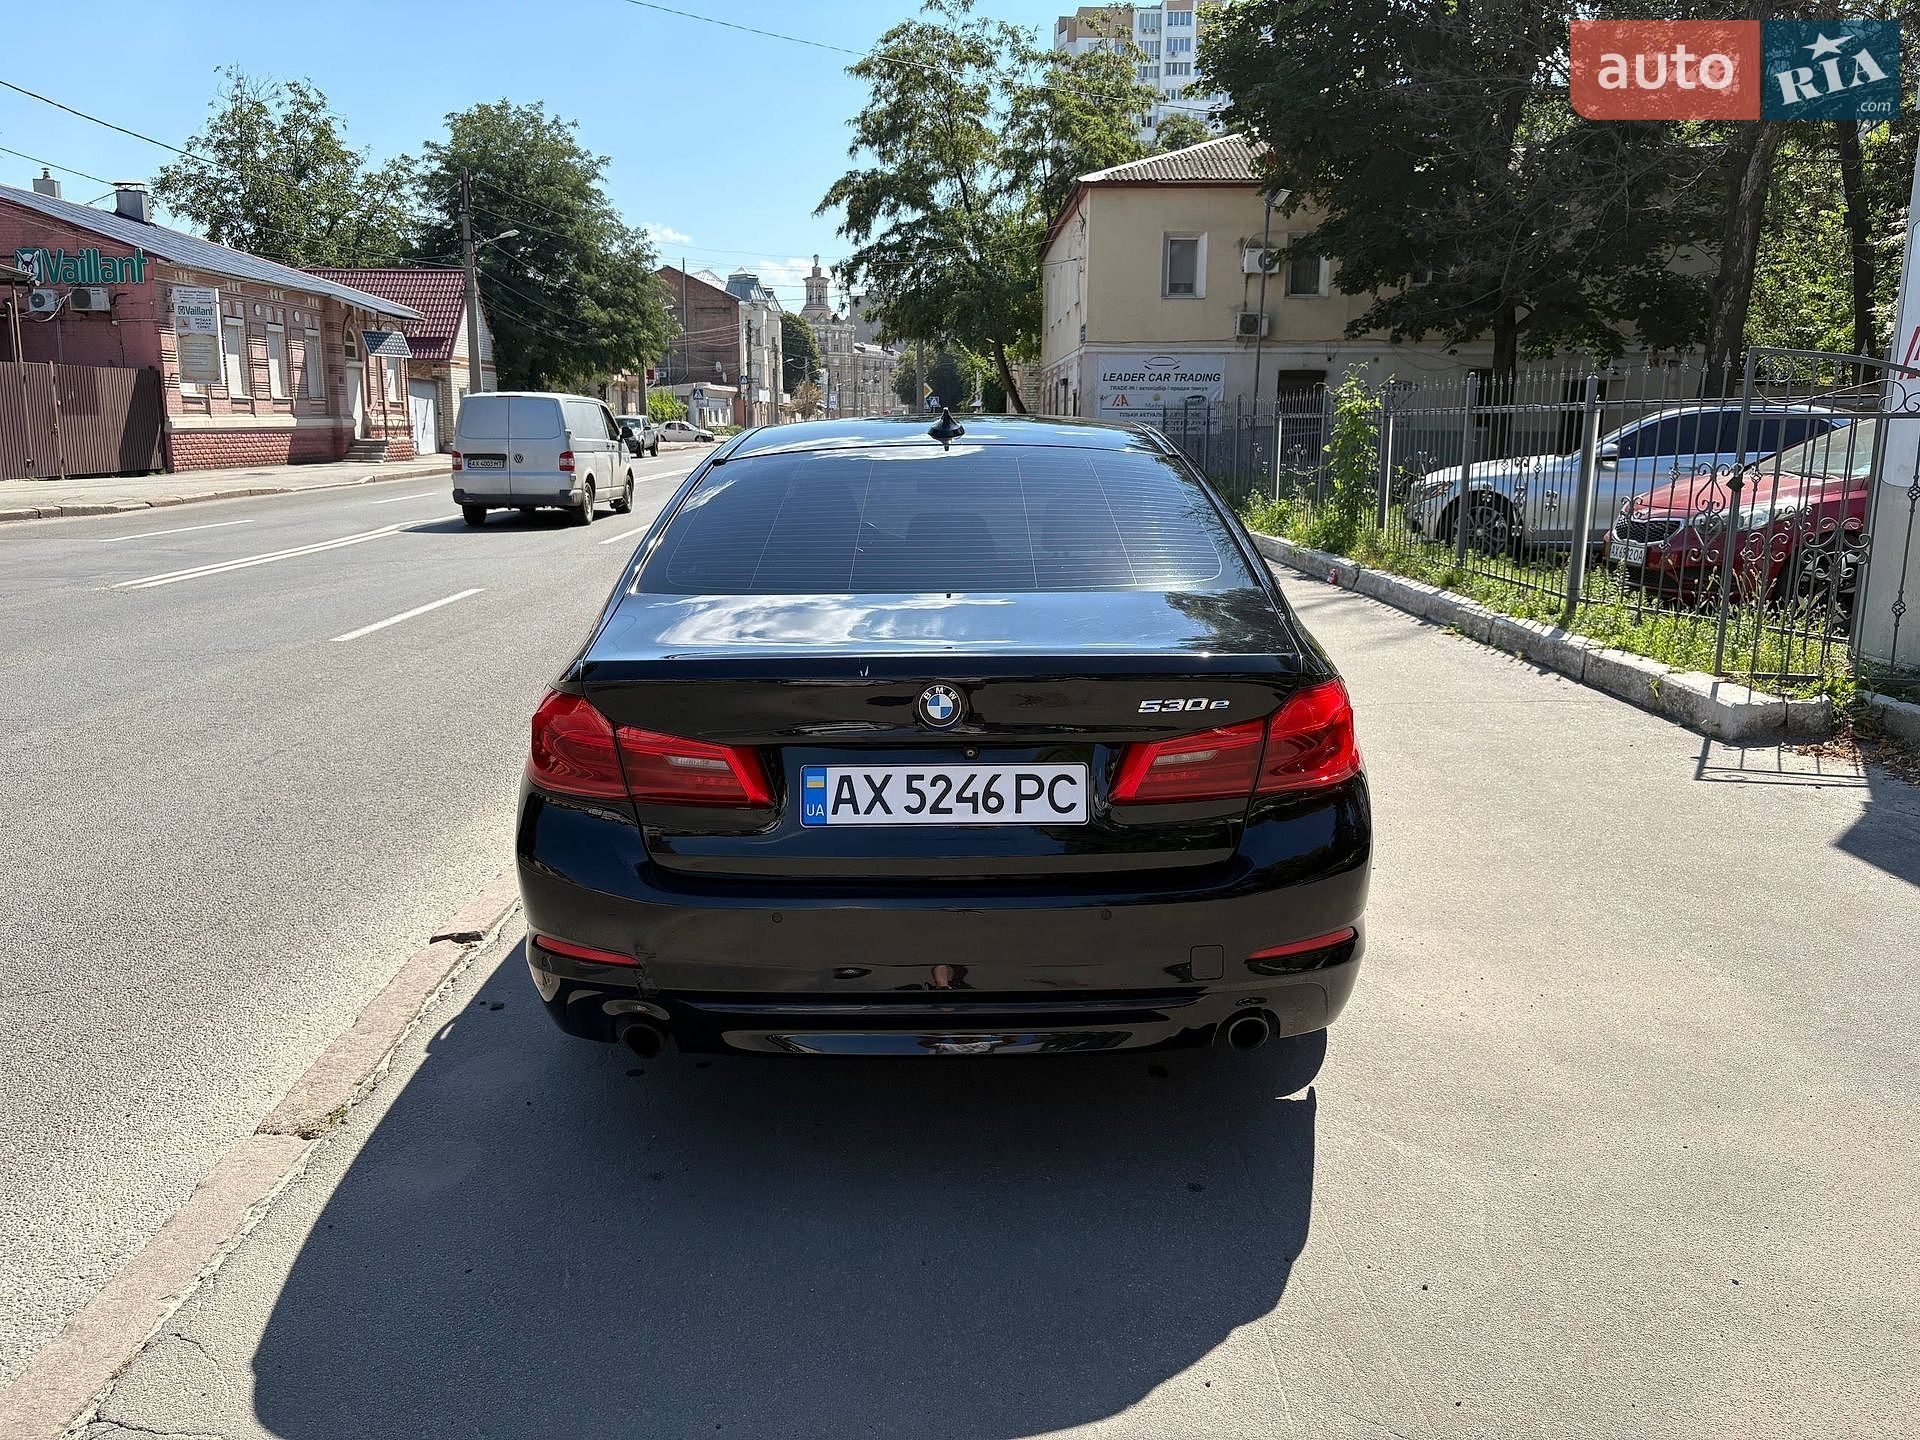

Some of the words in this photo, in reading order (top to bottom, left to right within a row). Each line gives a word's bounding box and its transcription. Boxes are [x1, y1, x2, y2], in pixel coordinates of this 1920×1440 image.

[40, 248, 148, 284] Vaillant
[185, 305, 213, 316] Vaillant
[1102, 372, 1146, 382] LEADER
[1148, 372, 1171, 382] CAR
[1174, 372, 1221, 382] TRADING
[923, 686, 958, 701] BMW
[1137, 697, 1230, 713] 530e
[831, 774, 893, 816] AX
[903, 774, 1005, 815] 5246
[1014, 773, 1078, 814] PC
[806, 803, 825, 817] UA
